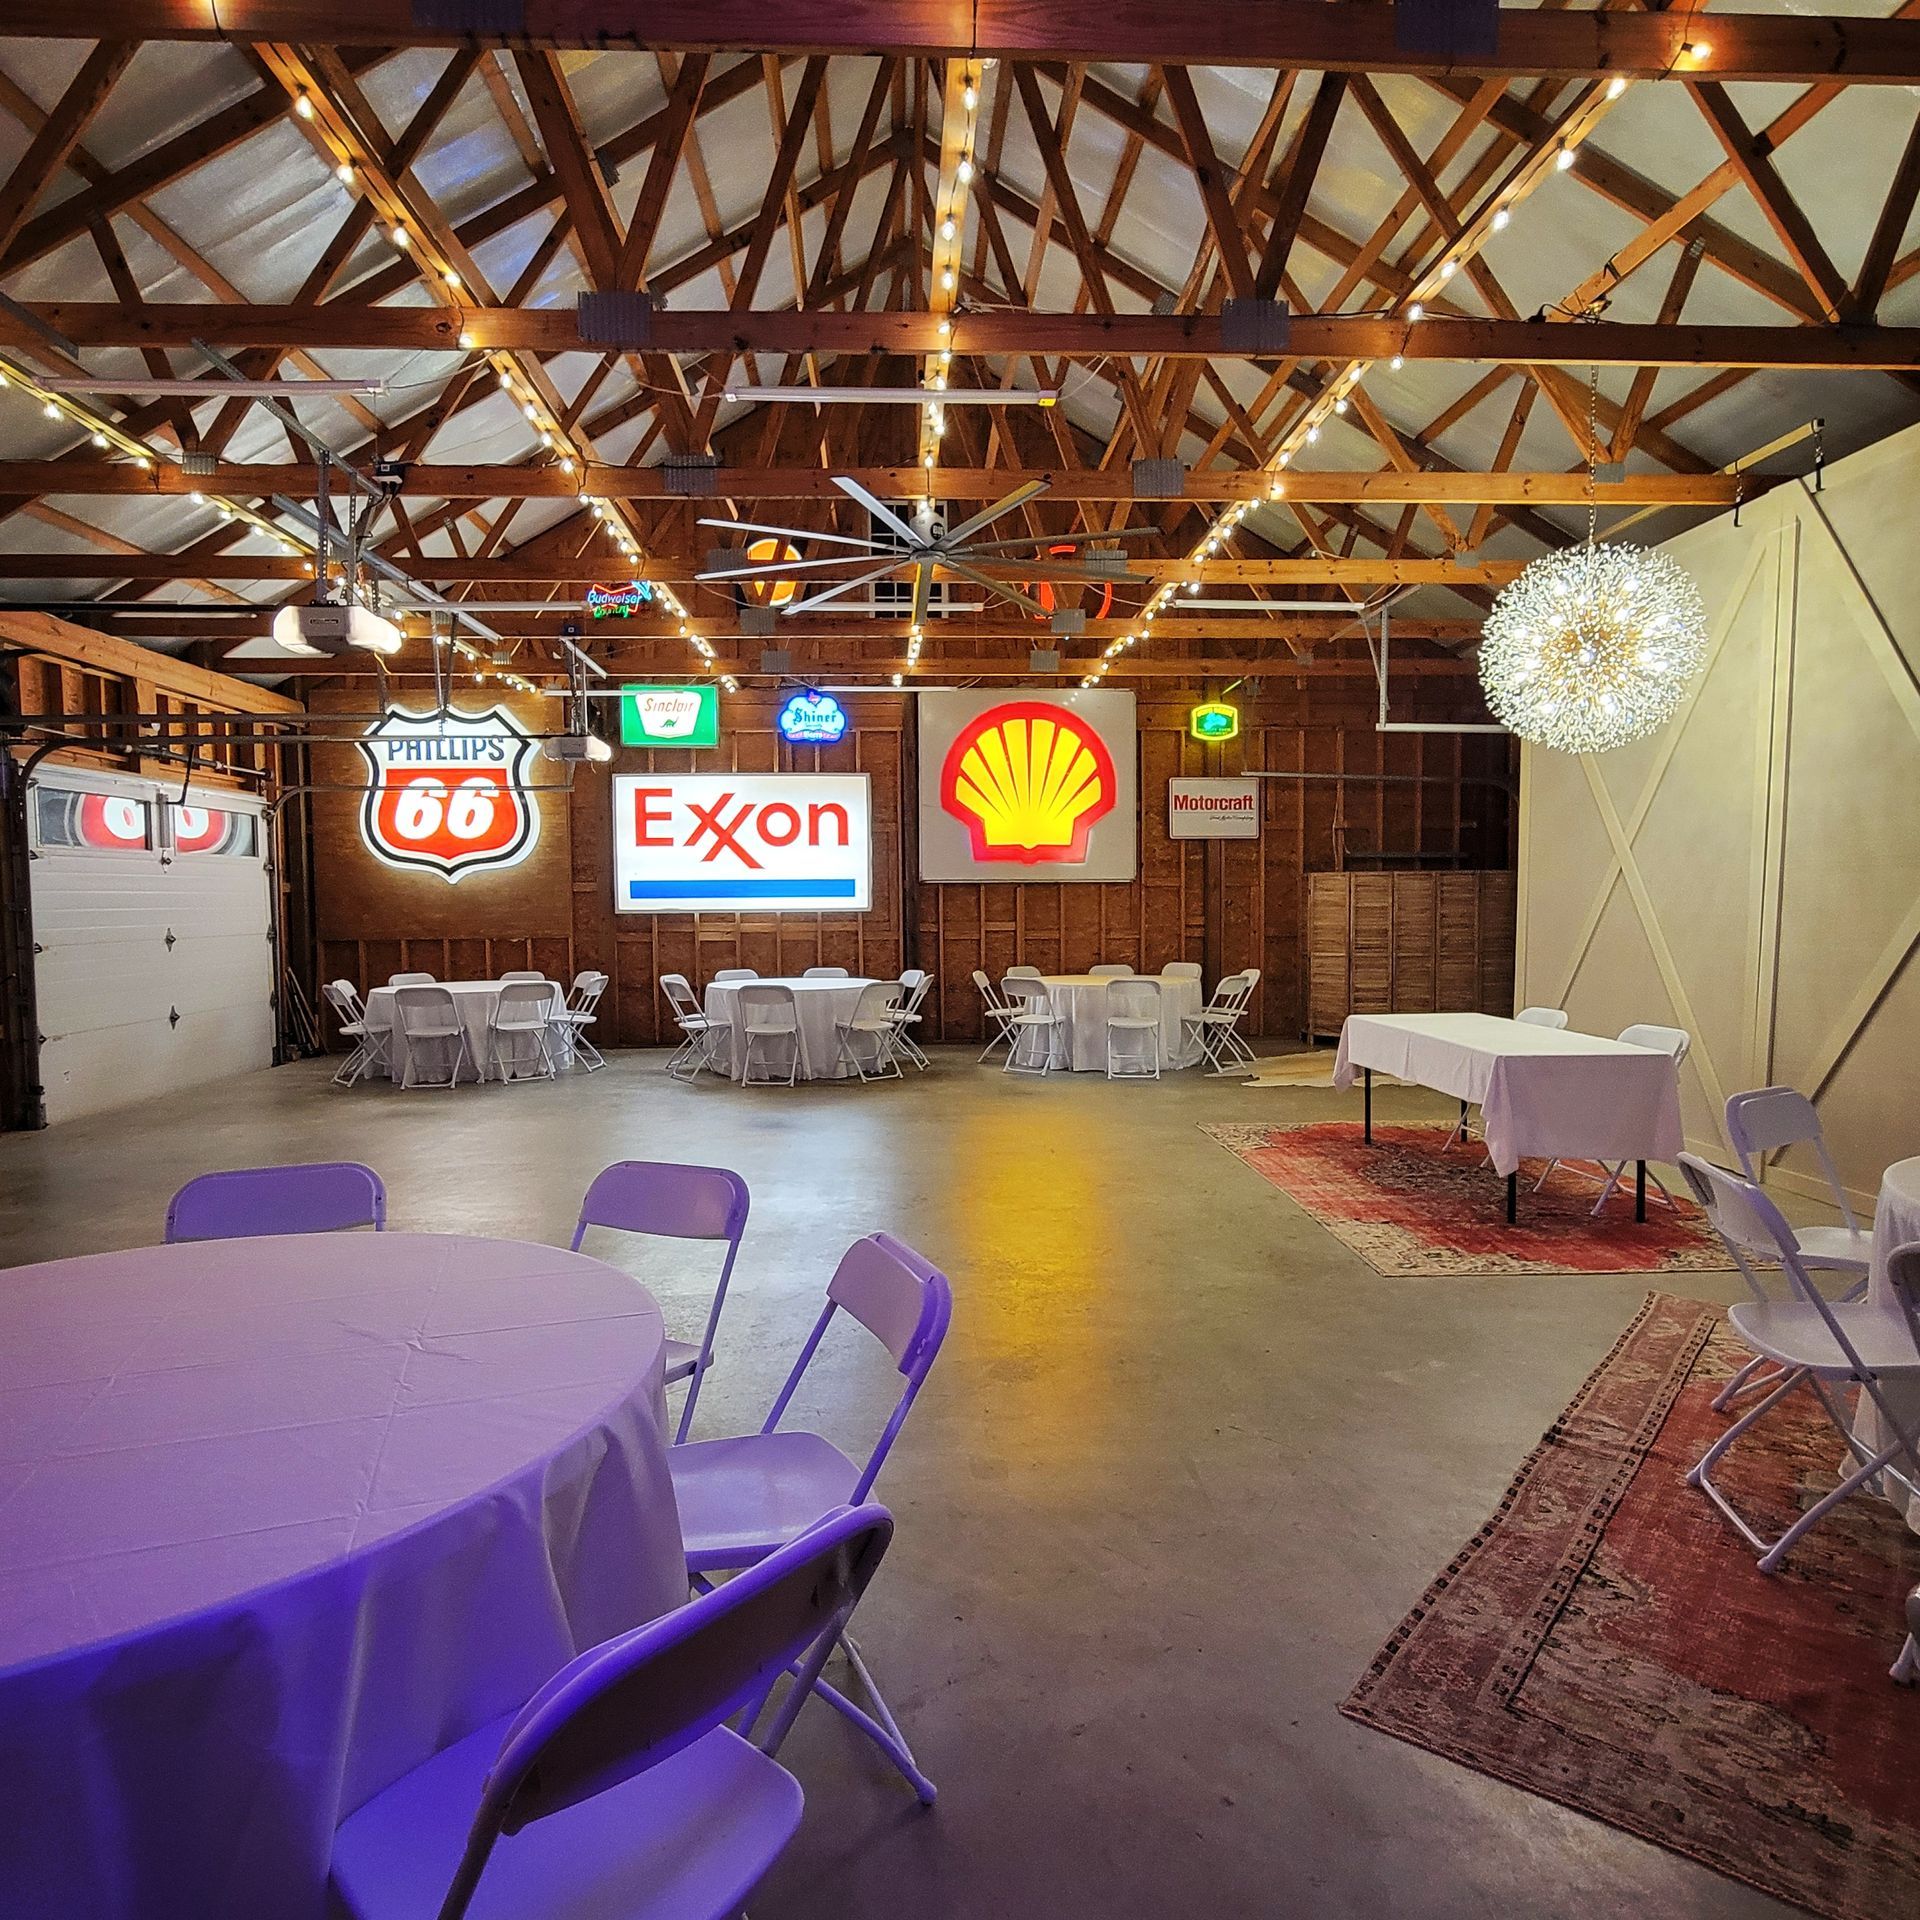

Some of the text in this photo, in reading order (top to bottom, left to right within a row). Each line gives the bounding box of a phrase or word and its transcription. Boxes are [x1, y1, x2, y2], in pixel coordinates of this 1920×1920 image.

[588, 590, 643, 604] Budweiser
[644, 698, 694, 712] Sinclair
[793, 707, 837, 725] Shiner
[388, 735, 505, 762] PHILLIPS
[394, 777, 500, 840] 66
[1173, 794, 1254, 811] Motorcraft
[634, 787, 850, 869] Exxon
